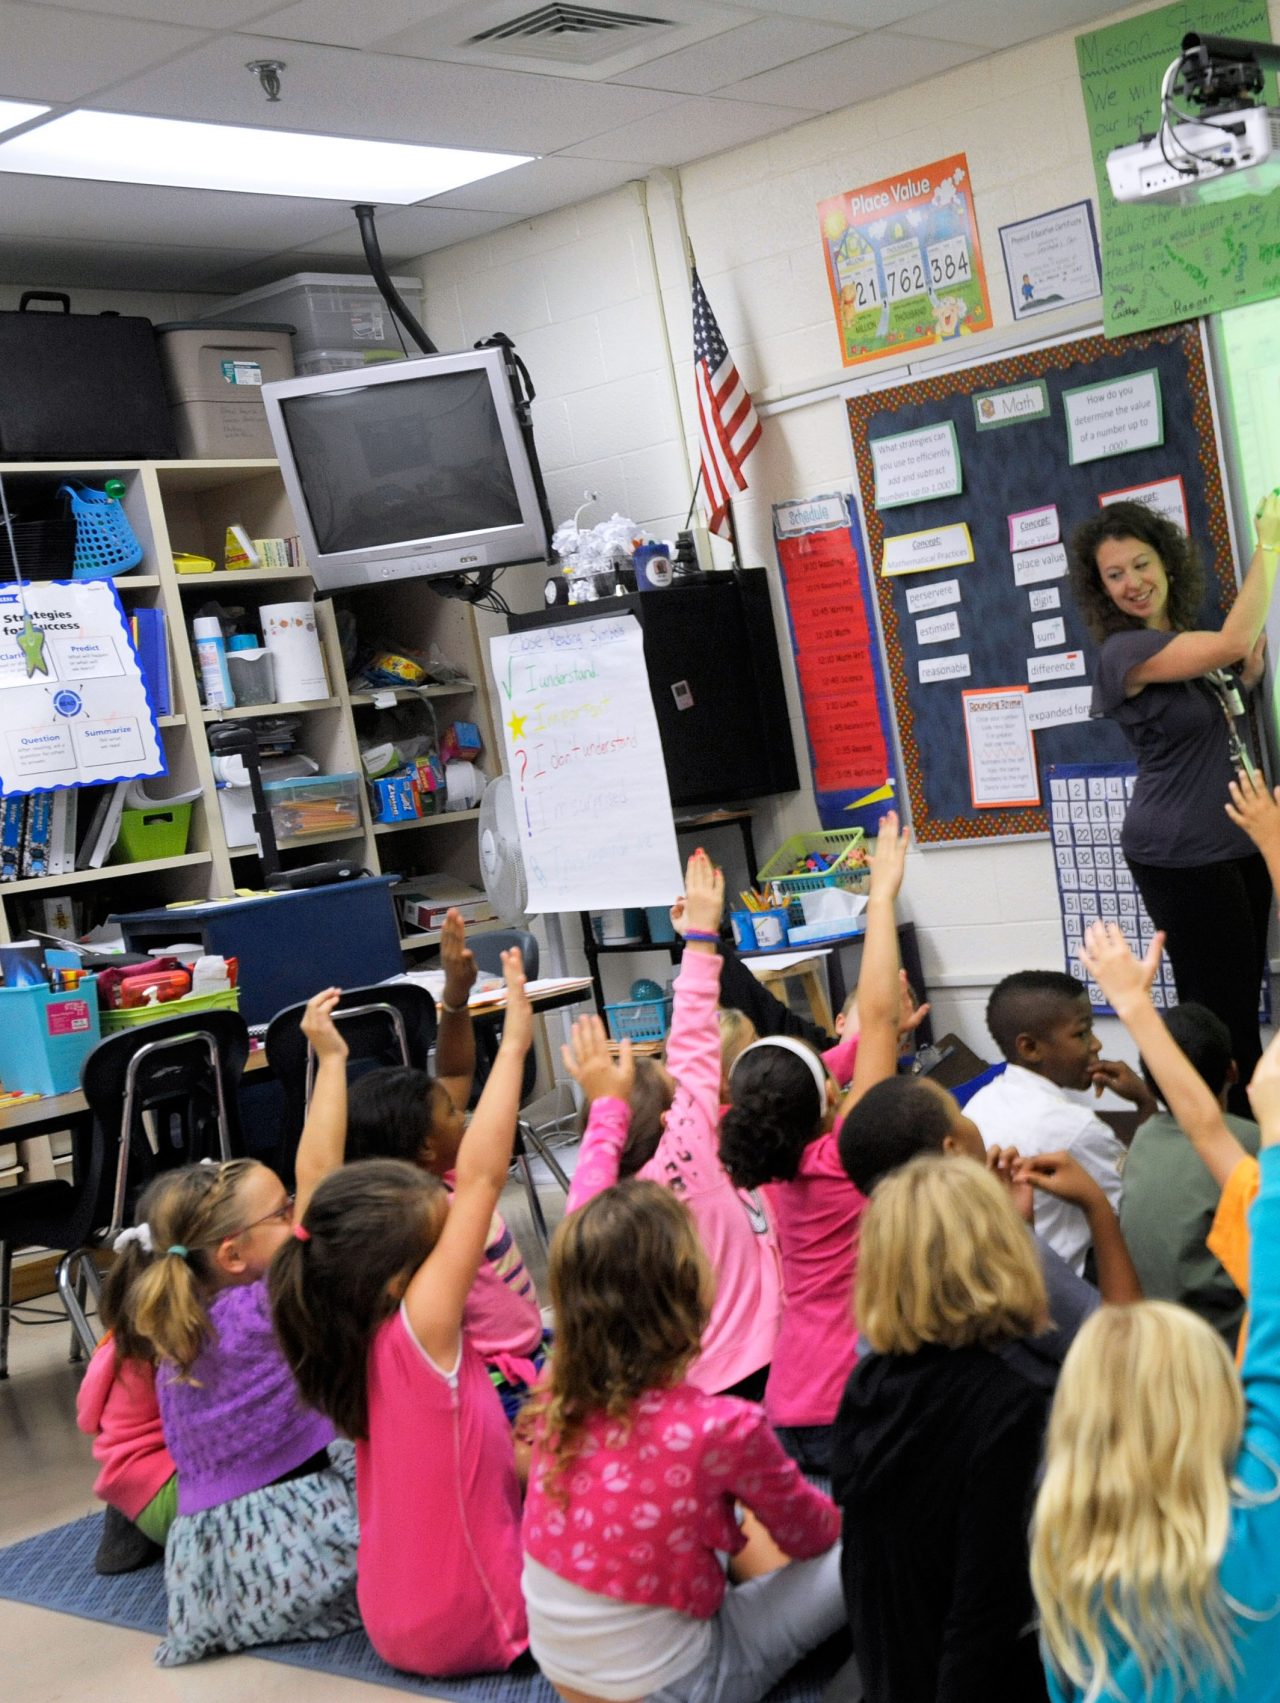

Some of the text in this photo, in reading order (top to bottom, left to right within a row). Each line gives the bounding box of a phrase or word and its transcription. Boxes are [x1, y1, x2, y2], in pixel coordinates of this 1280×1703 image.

[1088, 84, 1117, 113] We
[851, 178, 931, 217] Place Value
[931, 251, 968, 283] 384
[1001, 393, 1036, 414] Math
[1086, 386, 1134, 405] How do you
[1074, 399, 1151, 426] determine the value
[1080, 433, 1089, 443] of
[1096, 424, 1126, 438] number
[1127, 421, 1138, 432] up
[1139, 419, 1148, 427] to
[878, 432, 946, 454] What strategies can
[880, 463, 893, 472] you
[893, 460, 906, 468] use
[916, 448, 950, 463] efficiently
[888, 466, 945, 485] add and subtract
[879, 490, 910, 502] numbers
[910, 488, 920, 497] up
[789, 504, 829, 526] Schedule
[1020, 516, 1052, 531] Concept:
[912, 536, 942, 550] Concept:
[1016, 551, 1065, 572] place value
[909, 586, 953, 602] perservere
[1032, 594, 1053, 609] digit
[33, 621, 81, 632] uccess
[919, 621, 955, 637] estimate
[508, 634, 543, 653] Close
[1036, 631, 1056, 643] sum
[0, 644, 100, 661] Clari Predict
[921, 662, 968, 677] reasonable
[1030, 660, 1076, 676] difference
[525, 660, 600, 693] I understand
[1028, 709, 1073, 722] expanded
[20, 734, 61, 746] Question
[84, 726, 132, 738] Summarize
[1056, 781, 1118, 797] 1 2 3 4
[1056, 804, 1122, 819] 11 12 13 14
[1056, 829, 1069, 843] 21
[1075, 828, 1090, 842] 22
[1093, 828, 1108, 841] 23
[1059, 852, 1071, 865] 31
[1077, 851, 1090, 865] 32
[1095, 851, 1110, 865] 33
[1062, 873, 1131, 888] 41 42 43 44
[1066, 897, 1135, 912] 51 52 53 54
[1067, 919, 1079, 932] 61
[1120, 920, 1135, 933] 64
[1141, 920, 1156, 934] 65
[1072, 964, 1173, 981] 81 8
[1089, 989, 1104, 1002] 92
